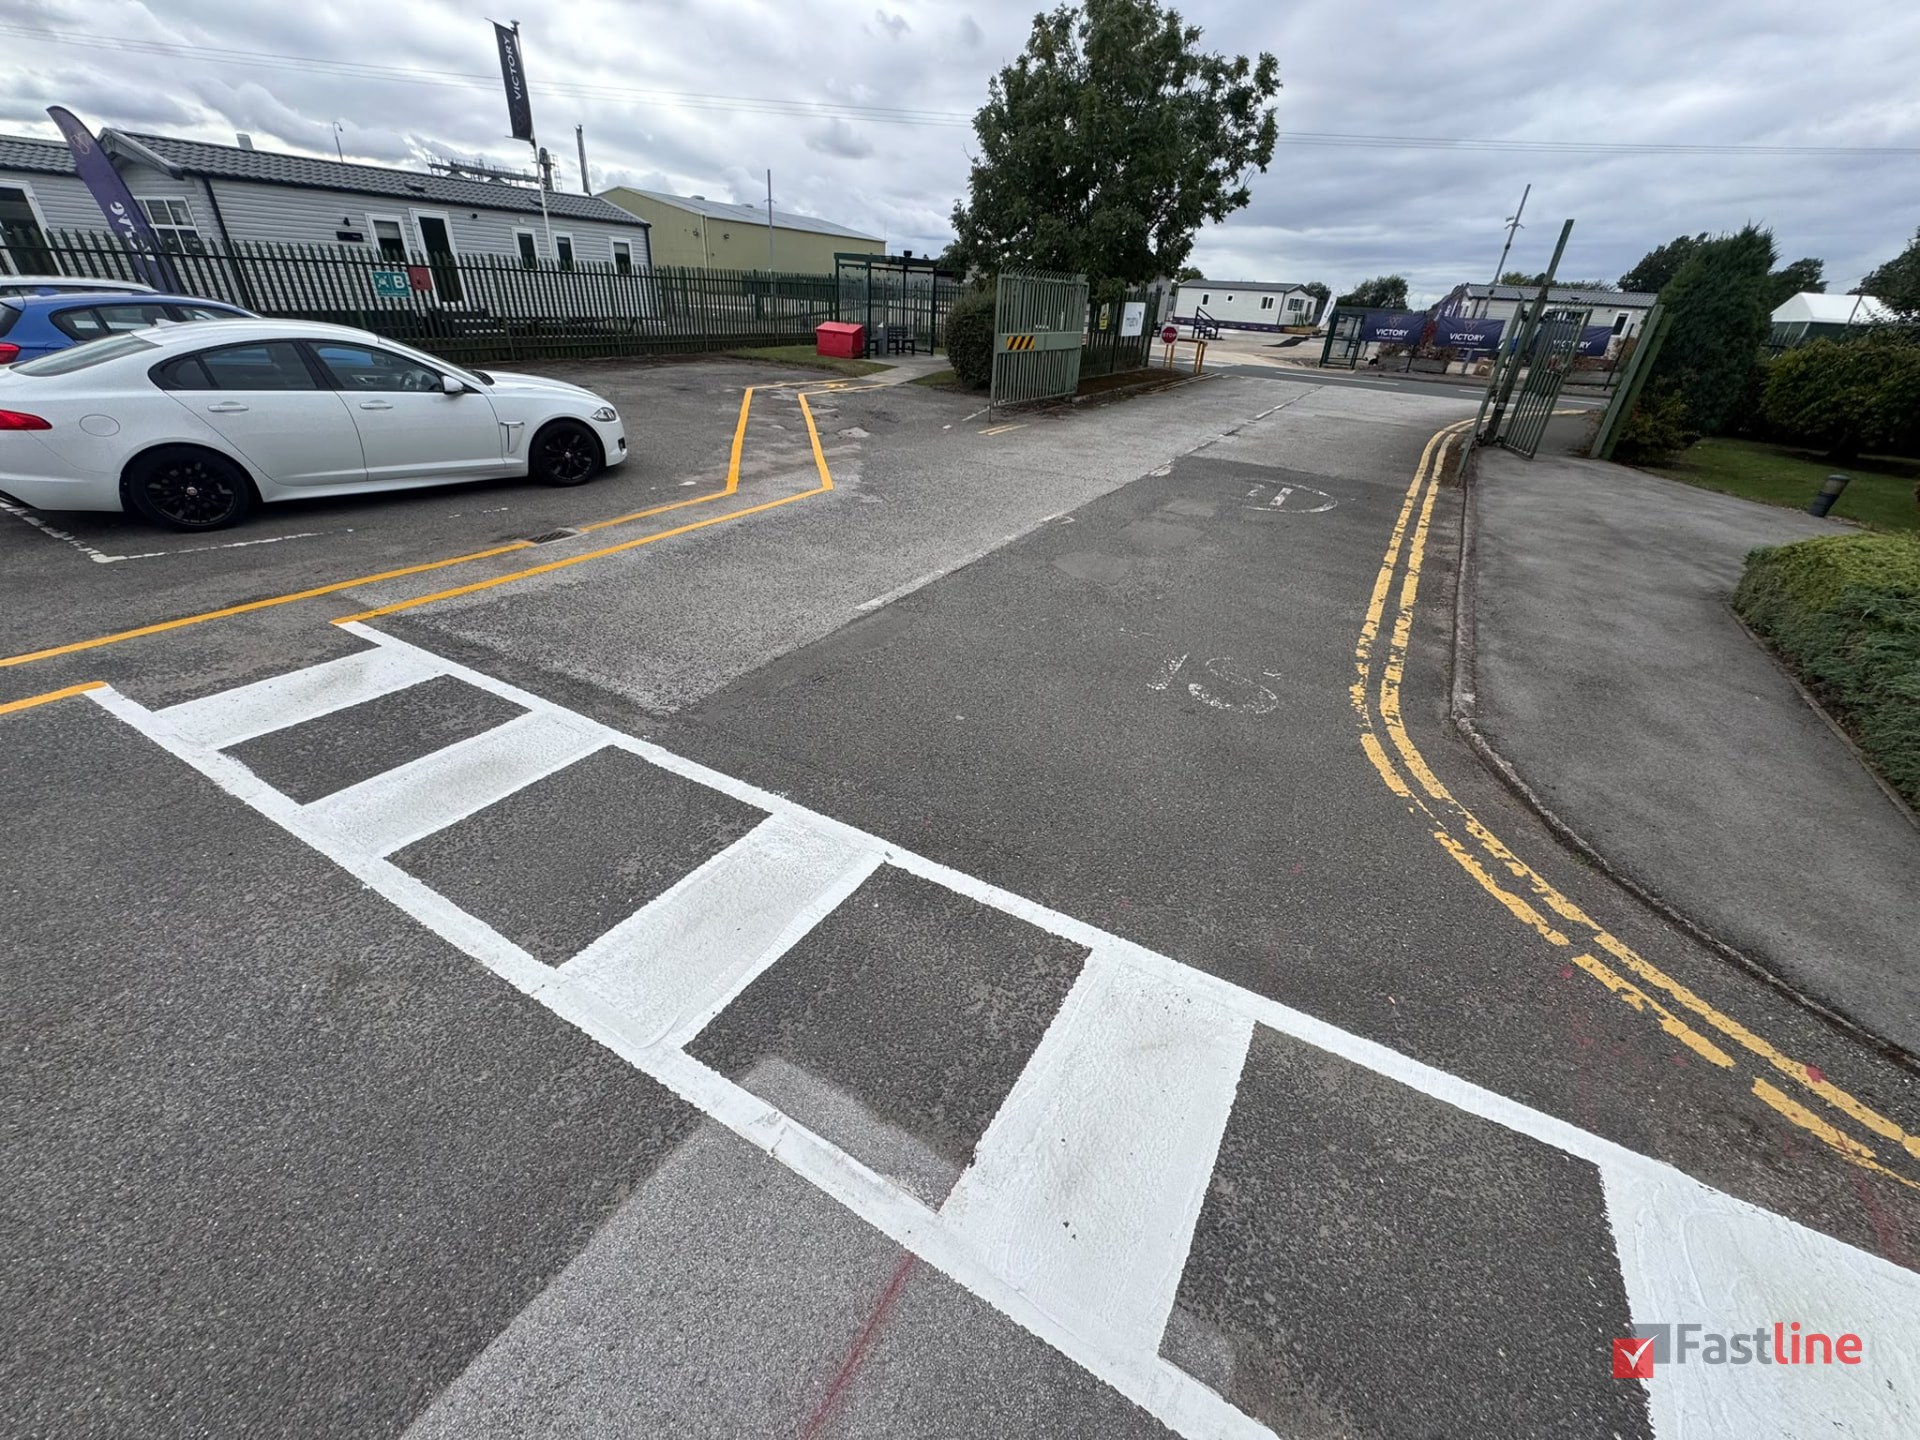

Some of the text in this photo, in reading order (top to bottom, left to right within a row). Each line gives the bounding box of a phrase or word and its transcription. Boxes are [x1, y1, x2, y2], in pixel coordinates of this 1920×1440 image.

[503, 35, 522, 100] VICTORY
[393, 275, 405, 289] B
[1376, 328, 1409, 337] VICTORY
[1450, 332, 1486, 342] VICTORY
